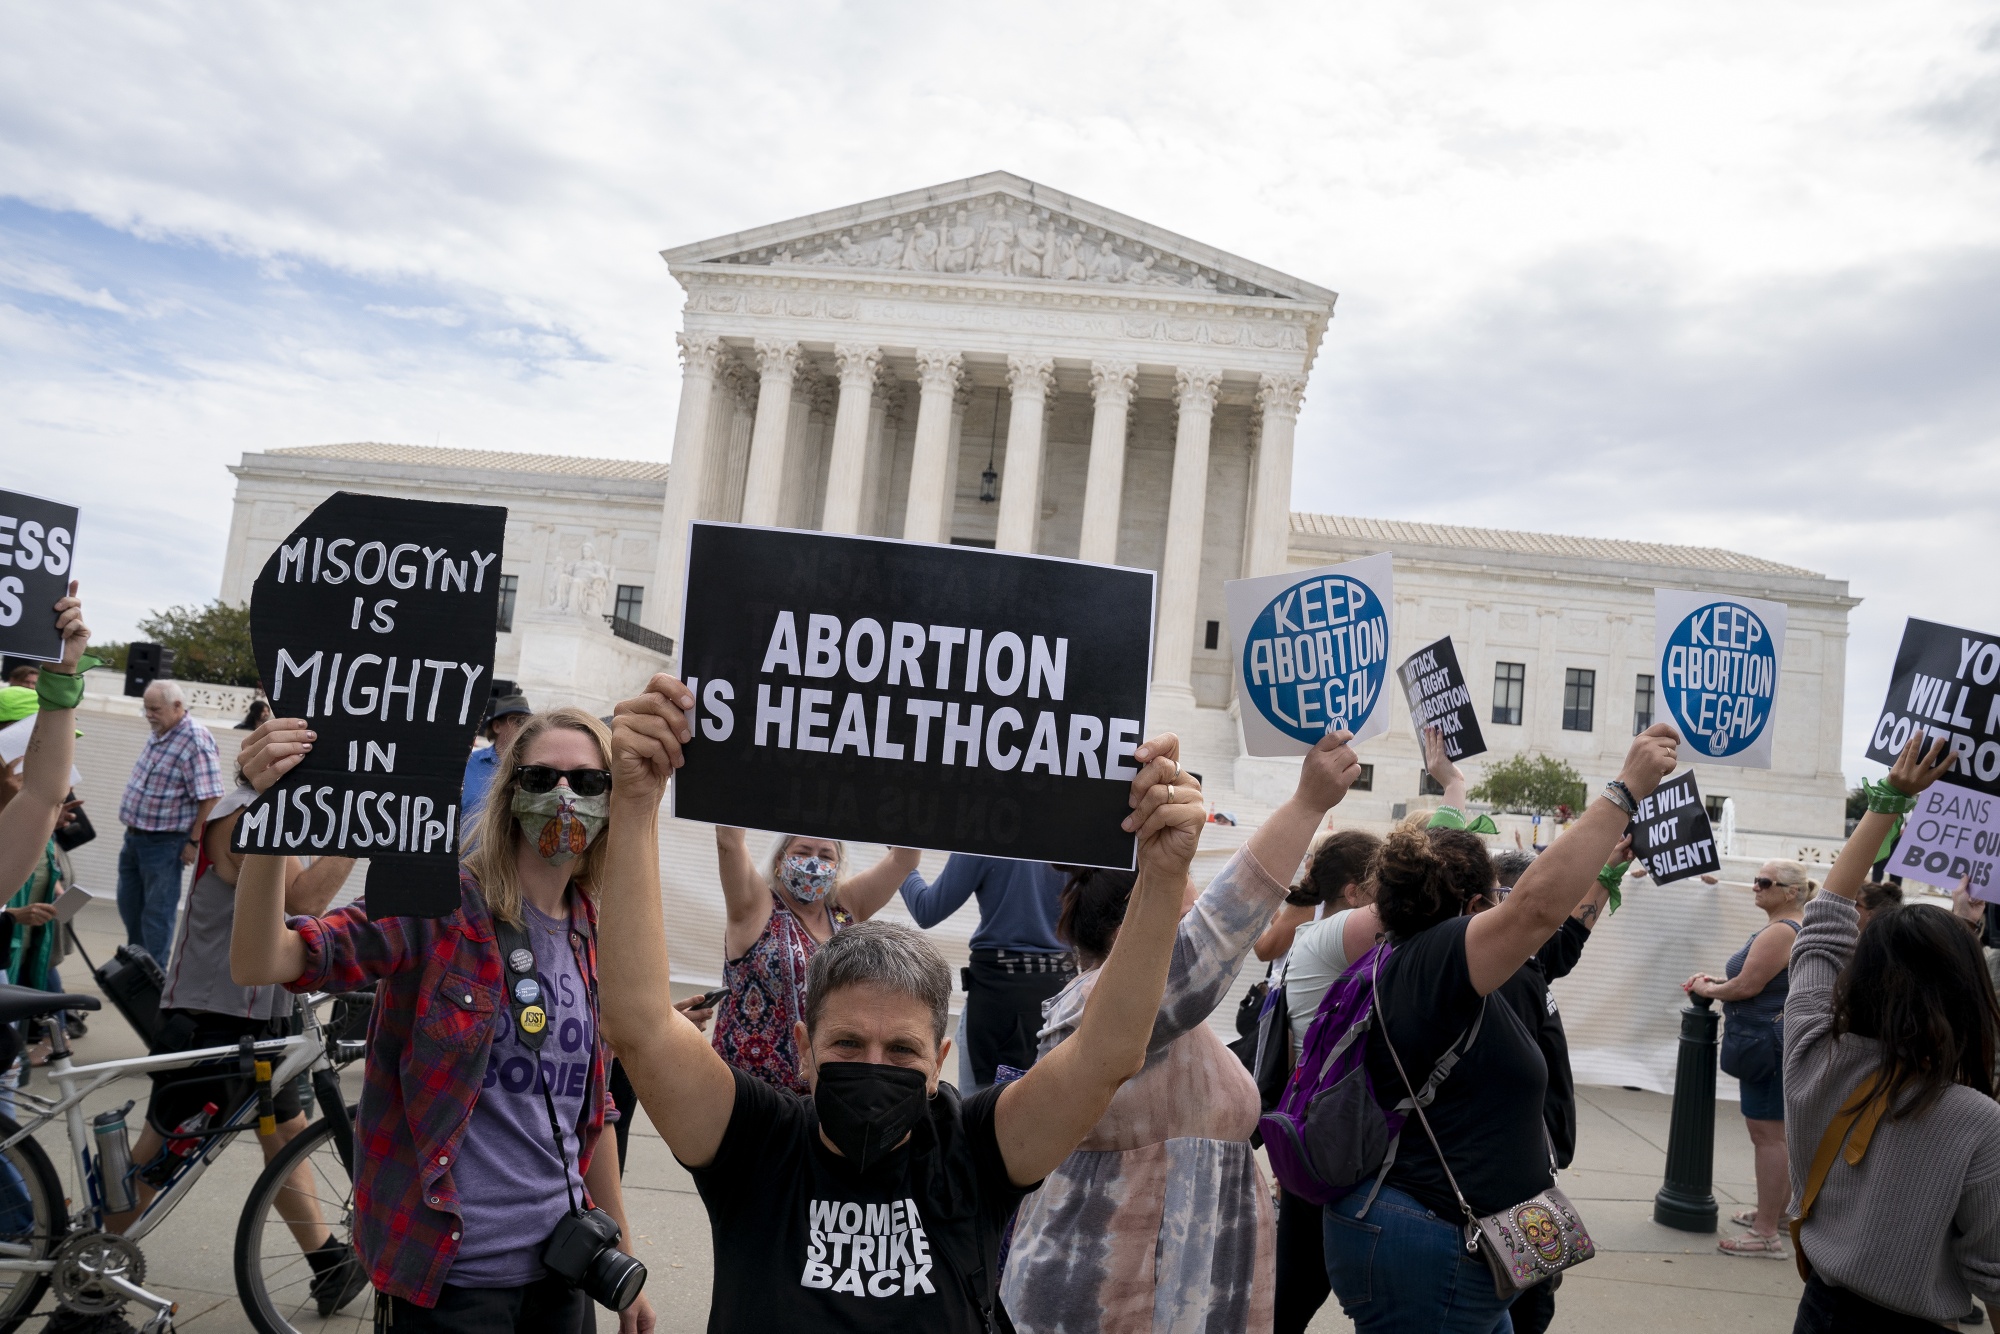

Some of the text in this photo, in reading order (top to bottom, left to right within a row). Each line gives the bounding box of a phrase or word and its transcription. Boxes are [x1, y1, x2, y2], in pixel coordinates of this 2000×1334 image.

[872, 305, 929, 321] EQUAL
[934, 308, 1001, 327] JUSTICE
[1009, 313, 1066, 330] UNDER
[278, 536, 497, 593] MISOGYNY
[352, 597, 398, 634] IS
[1273, 579, 1366, 634] KEEP
[1691, 605, 1762, 651] KEEP
[761, 610, 1068, 701] ABORTION
[1251, 616, 1385, 686] ABORTION
[1667, 645, 1772, 698] ABORTION
[272, 648, 485, 725] MIGHTY
[1270, 668, 1376, 729] LEGAL
[1421, 668, 1450, 697] RIGHT
[1423, 684, 1471, 719] ABORTION
[1906, 672, 1973, 730] WILL
[754, 683, 1140, 781] HEALTHCARE
[1680, 690, 1762, 739] LEGAL
[348, 740, 397, 773] IN
[1656, 782, 1695, 815] WILL
[1926, 792, 1991, 824] BANS
[1648, 817, 1678, 848] NOT
[1917, 820, 2000, 857] OFF OU
[1652, 839, 1712, 877] SILENT
[1902, 844, 1993, 887] BODIES
[809, 1198, 923, 1236] WOMEN
[807, 1228, 932, 1272] STRIKE
[800, 1258, 936, 1298] BACK
